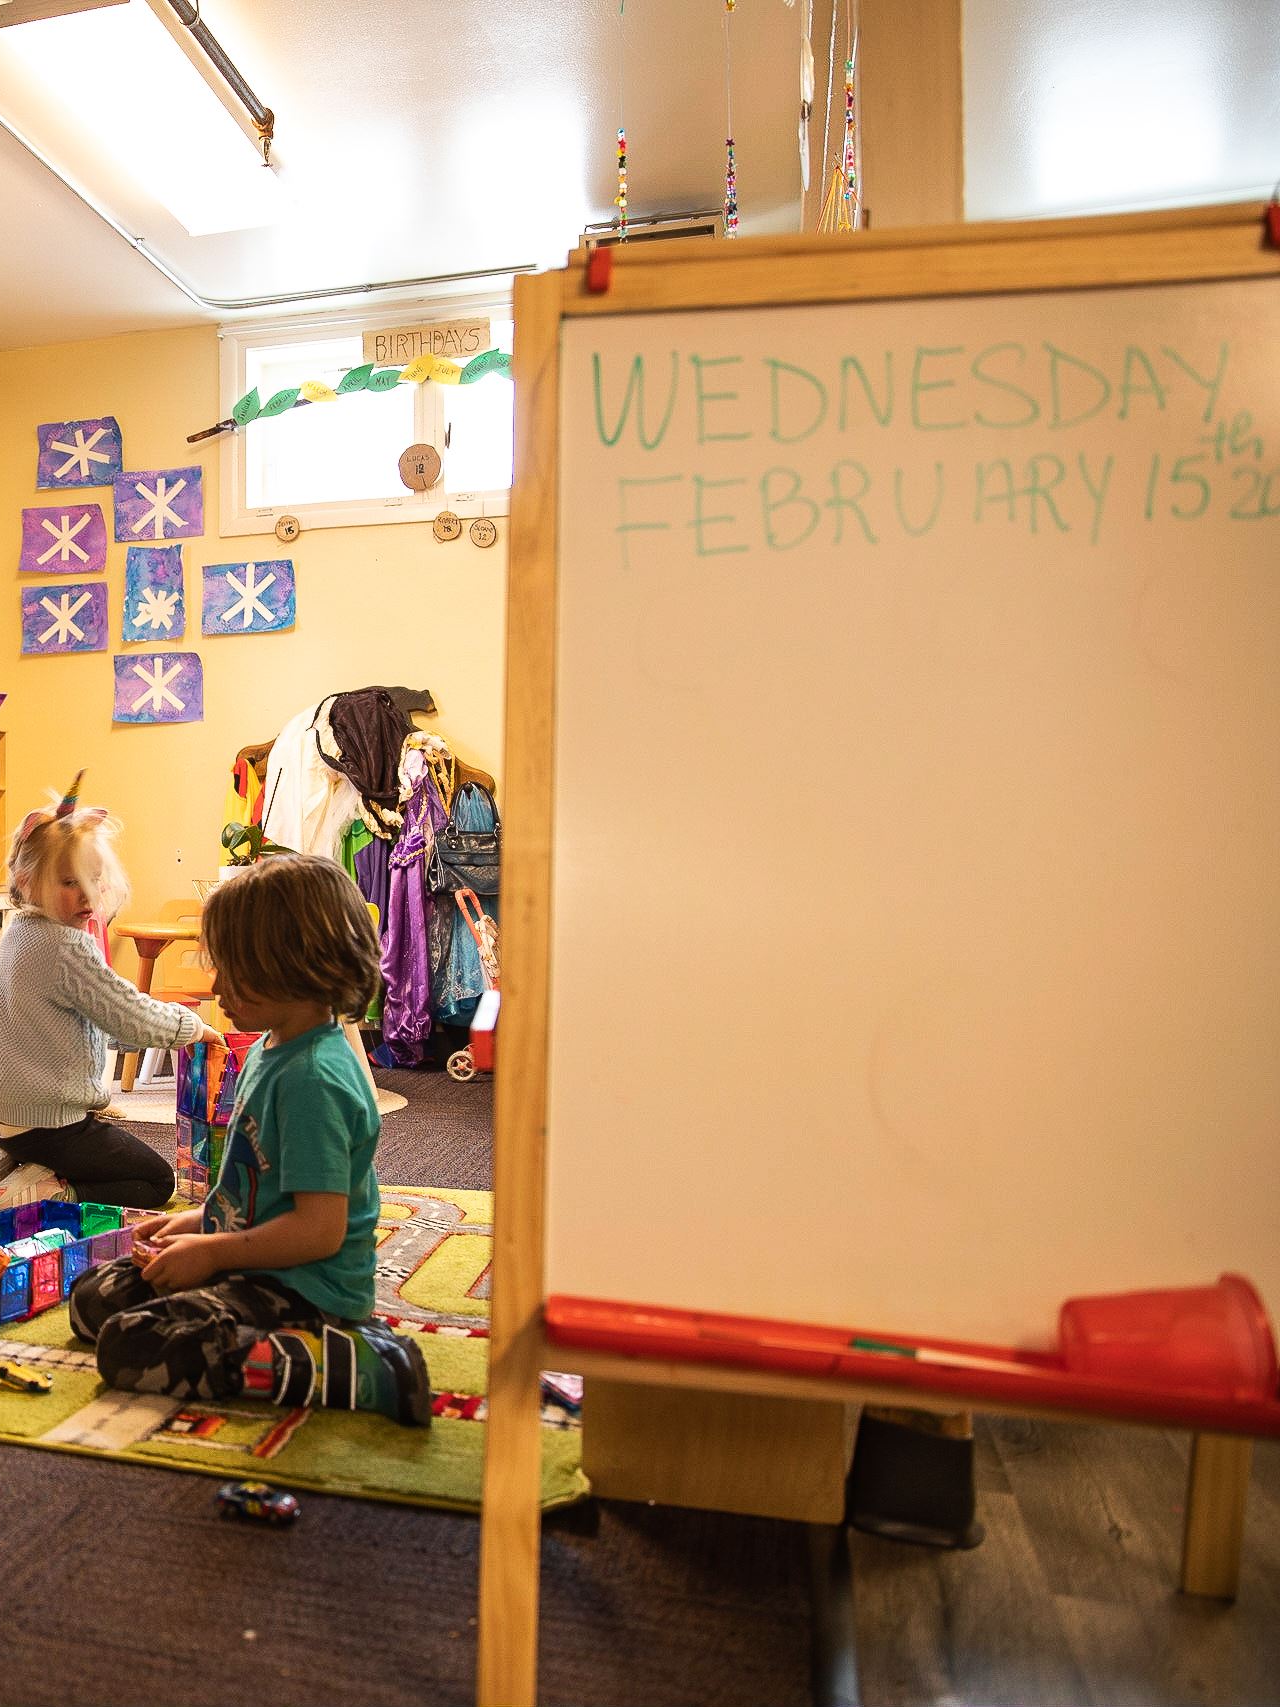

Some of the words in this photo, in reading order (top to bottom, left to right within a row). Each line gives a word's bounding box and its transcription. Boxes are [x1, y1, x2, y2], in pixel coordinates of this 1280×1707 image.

[375, 327, 480, 362] BIRTHDAYS
[406, 364, 424, 380] JUNE
[434, 364, 457, 376] JULY
[466, 355, 489, 378] AUGUST
[342, 376, 362, 392] APRIL
[375, 376, 391, 387] MAY
[590, 340, 1231, 453] WEDNESDAY
[613, 451, 1116, 572] FEBRUARY
